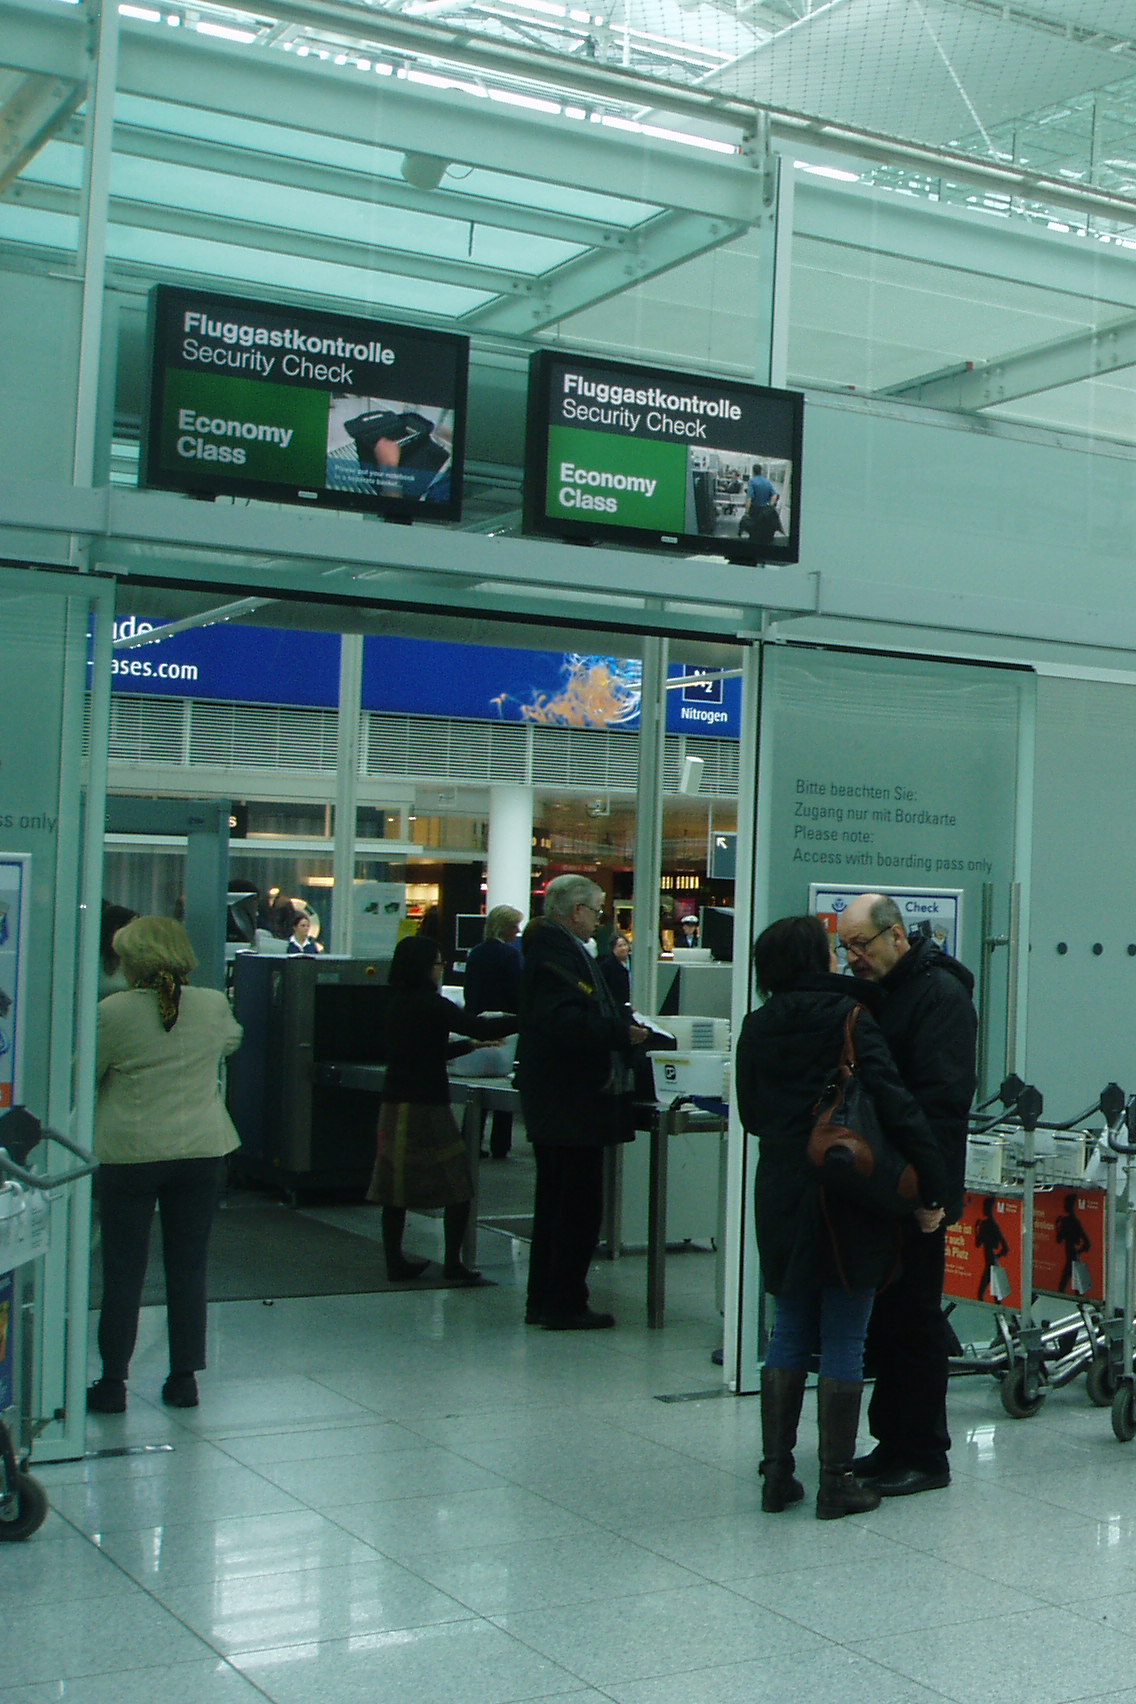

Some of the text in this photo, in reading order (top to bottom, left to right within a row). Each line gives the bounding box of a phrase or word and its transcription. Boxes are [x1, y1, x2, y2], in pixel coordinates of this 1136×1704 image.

[184, 311, 396, 365] Fluggastkontrolle
[182, 338, 354, 385] Security Check
[563, 374, 742, 421] Fluggastkontrolle
[178, 408, 294, 449] Economy
[562, 398, 707, 439] Security Check
[176, 436, 247, 465] Class
[560, 463, 657, 497] Economy
[558, 487, 618, 513] Class
[681, 707, 728, 724] Nitrogen
[796, 779, 918, 801] Bitte beachten Sie:
[20, 812, 59, 833] only
[794, 802, 957, 826] Zugang nur mit Bordkarte
[794, 825, 874, 844] Please note:
[793, 848, 993, 875] Access with boarding pass only
[905, 901, 939, 913] Check
